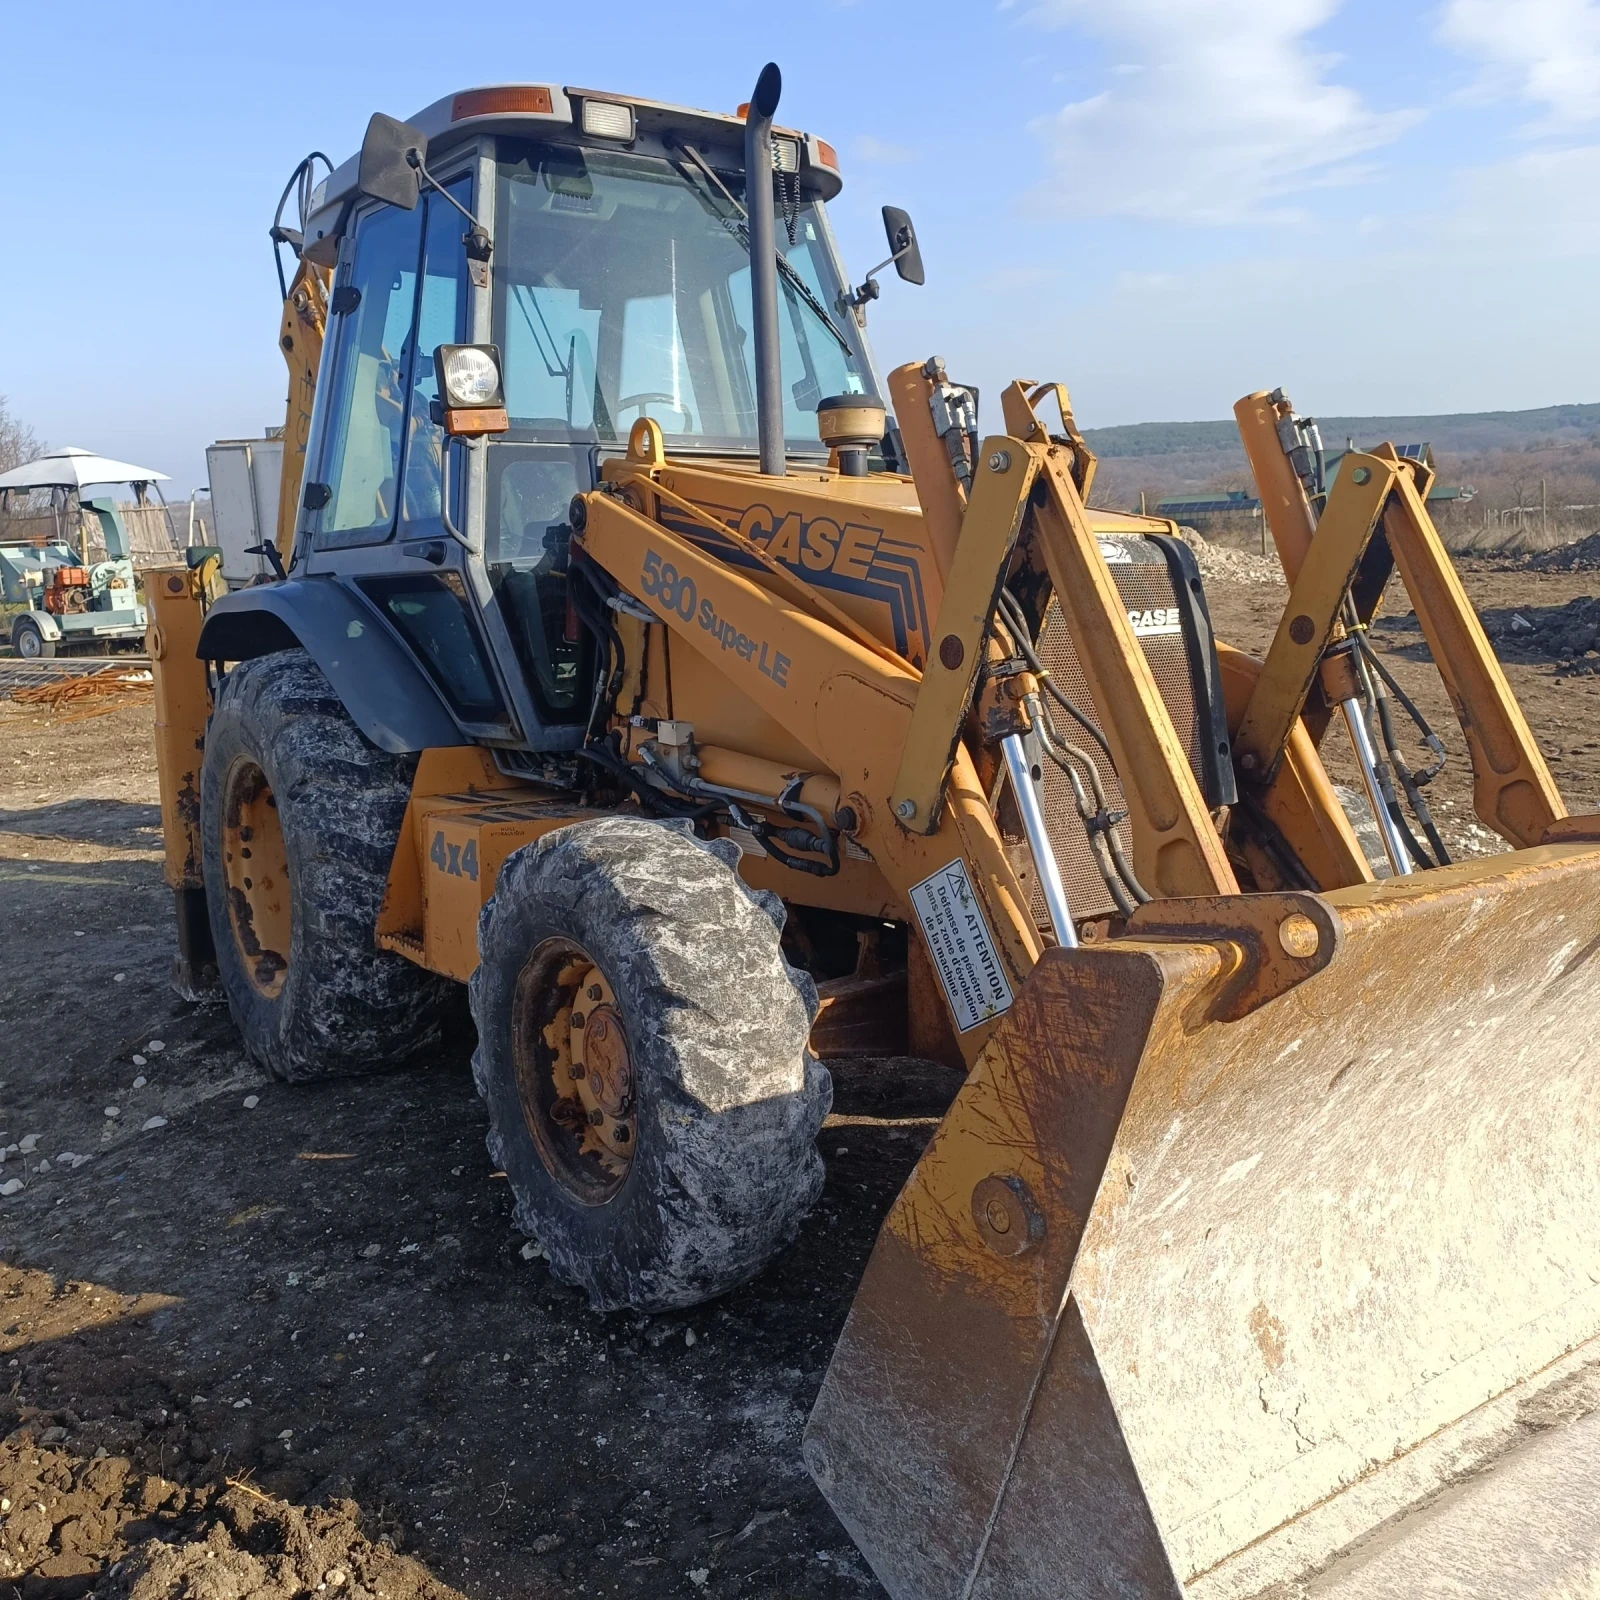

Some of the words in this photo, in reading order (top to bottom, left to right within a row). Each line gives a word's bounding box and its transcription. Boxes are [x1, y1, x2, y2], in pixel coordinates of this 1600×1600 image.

[738, 503, 884, 581] CASE
[641, 549, 697, 622] 580
[698, 598, 758, 662] Super
[758, 641, 791, 688] LE
[1127, 608, 1180, 628] CASE
[430, 830, 479, 882] 4x4
[924, 883, 939, 915] dans
[936, 912, 944, 926] la
[940, 926, 955, 955] zone
[951, 957, 979, 1021] d'évolution
[925, 916, 935, 931] de
[931, 931, 940, 945] la
[936, 947, 959, 998] machine
[937, 885, 960, 935] Défense
[956, 936, 966, 953] de
[961, 954, 986, 1005] pénétrer
[964, 913, 1006, 1001] ATTENTION
